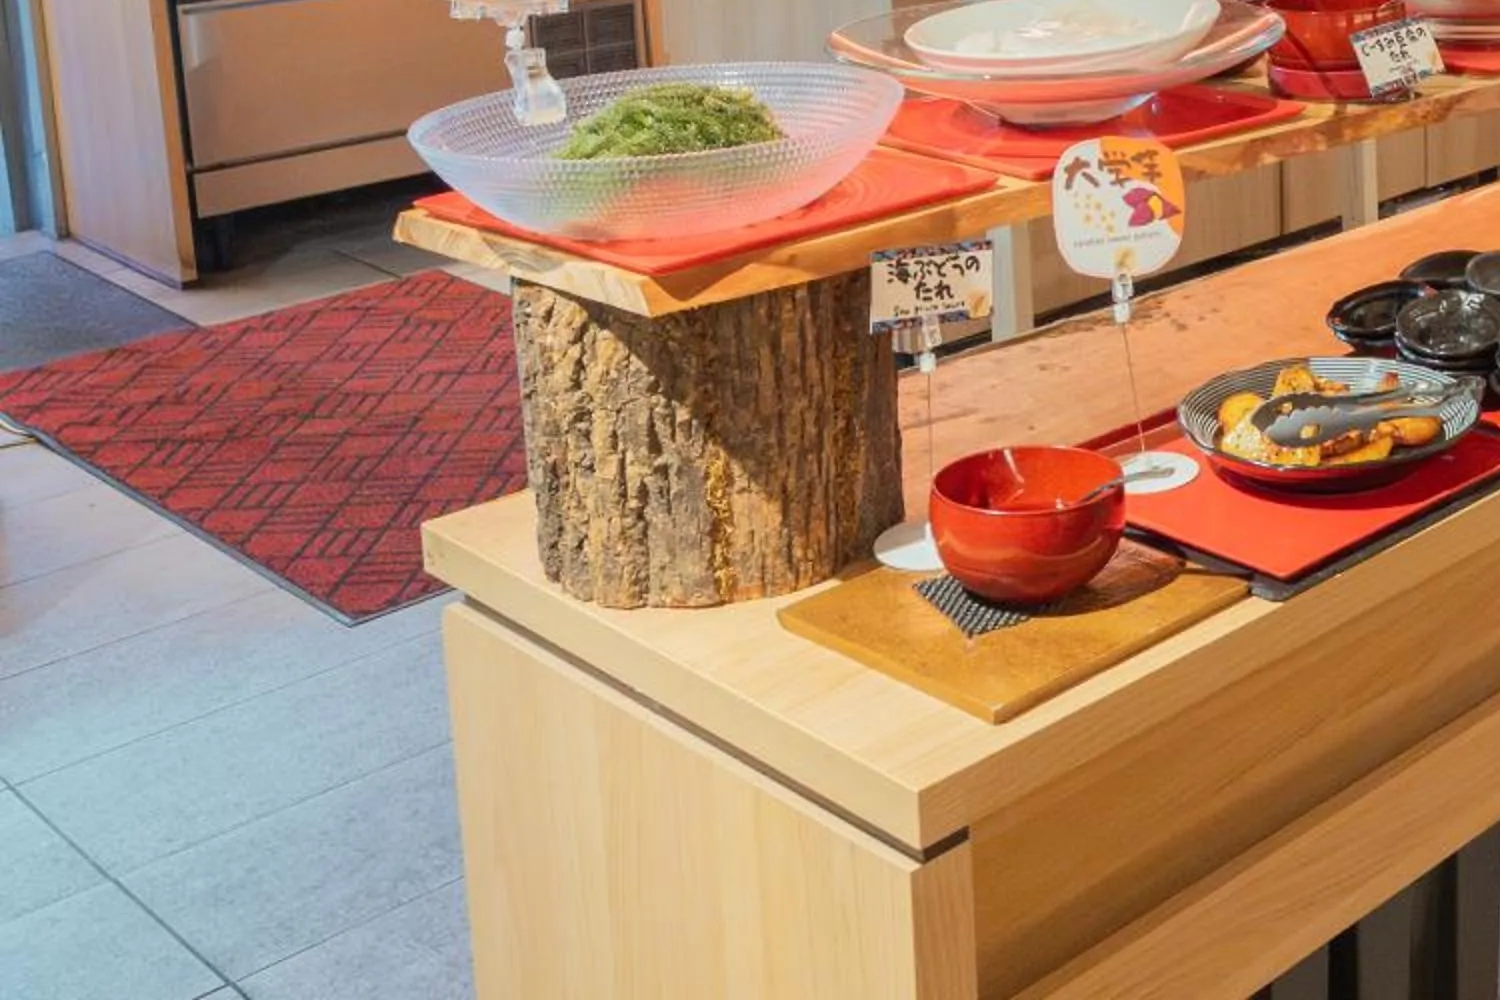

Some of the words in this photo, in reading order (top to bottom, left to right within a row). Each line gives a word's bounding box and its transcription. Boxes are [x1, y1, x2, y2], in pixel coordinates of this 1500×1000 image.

[1064, 149, 1163, 190] 大学芋
[886, 254, 981, 284] 海ぶどうの
[914, 280, 955, 300] たれ
